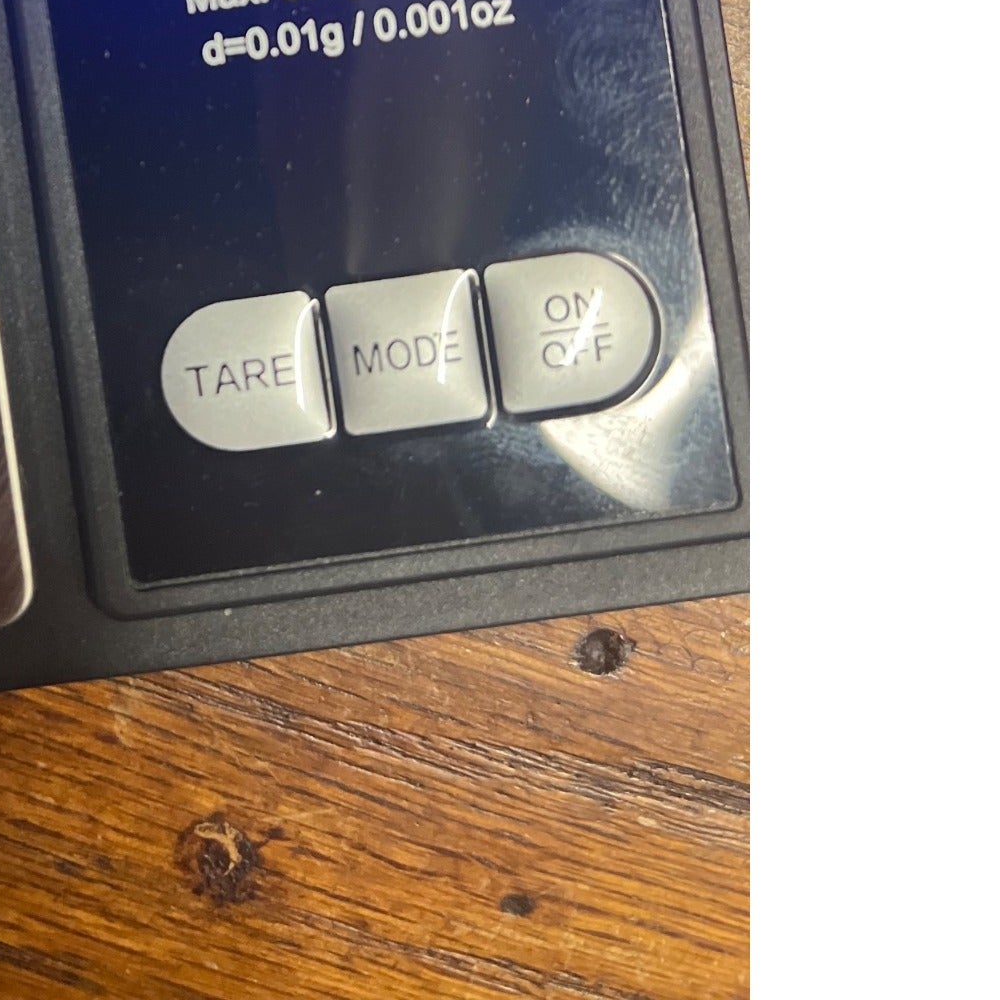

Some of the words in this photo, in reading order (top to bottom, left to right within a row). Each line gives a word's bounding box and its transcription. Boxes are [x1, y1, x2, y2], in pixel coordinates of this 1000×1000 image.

[201, 19, 345, 67] d=0.01g
[352, 12, 365, 47] /
[185, 352, 297, 398] TARE
[353, 330, 462, 376] MODE
